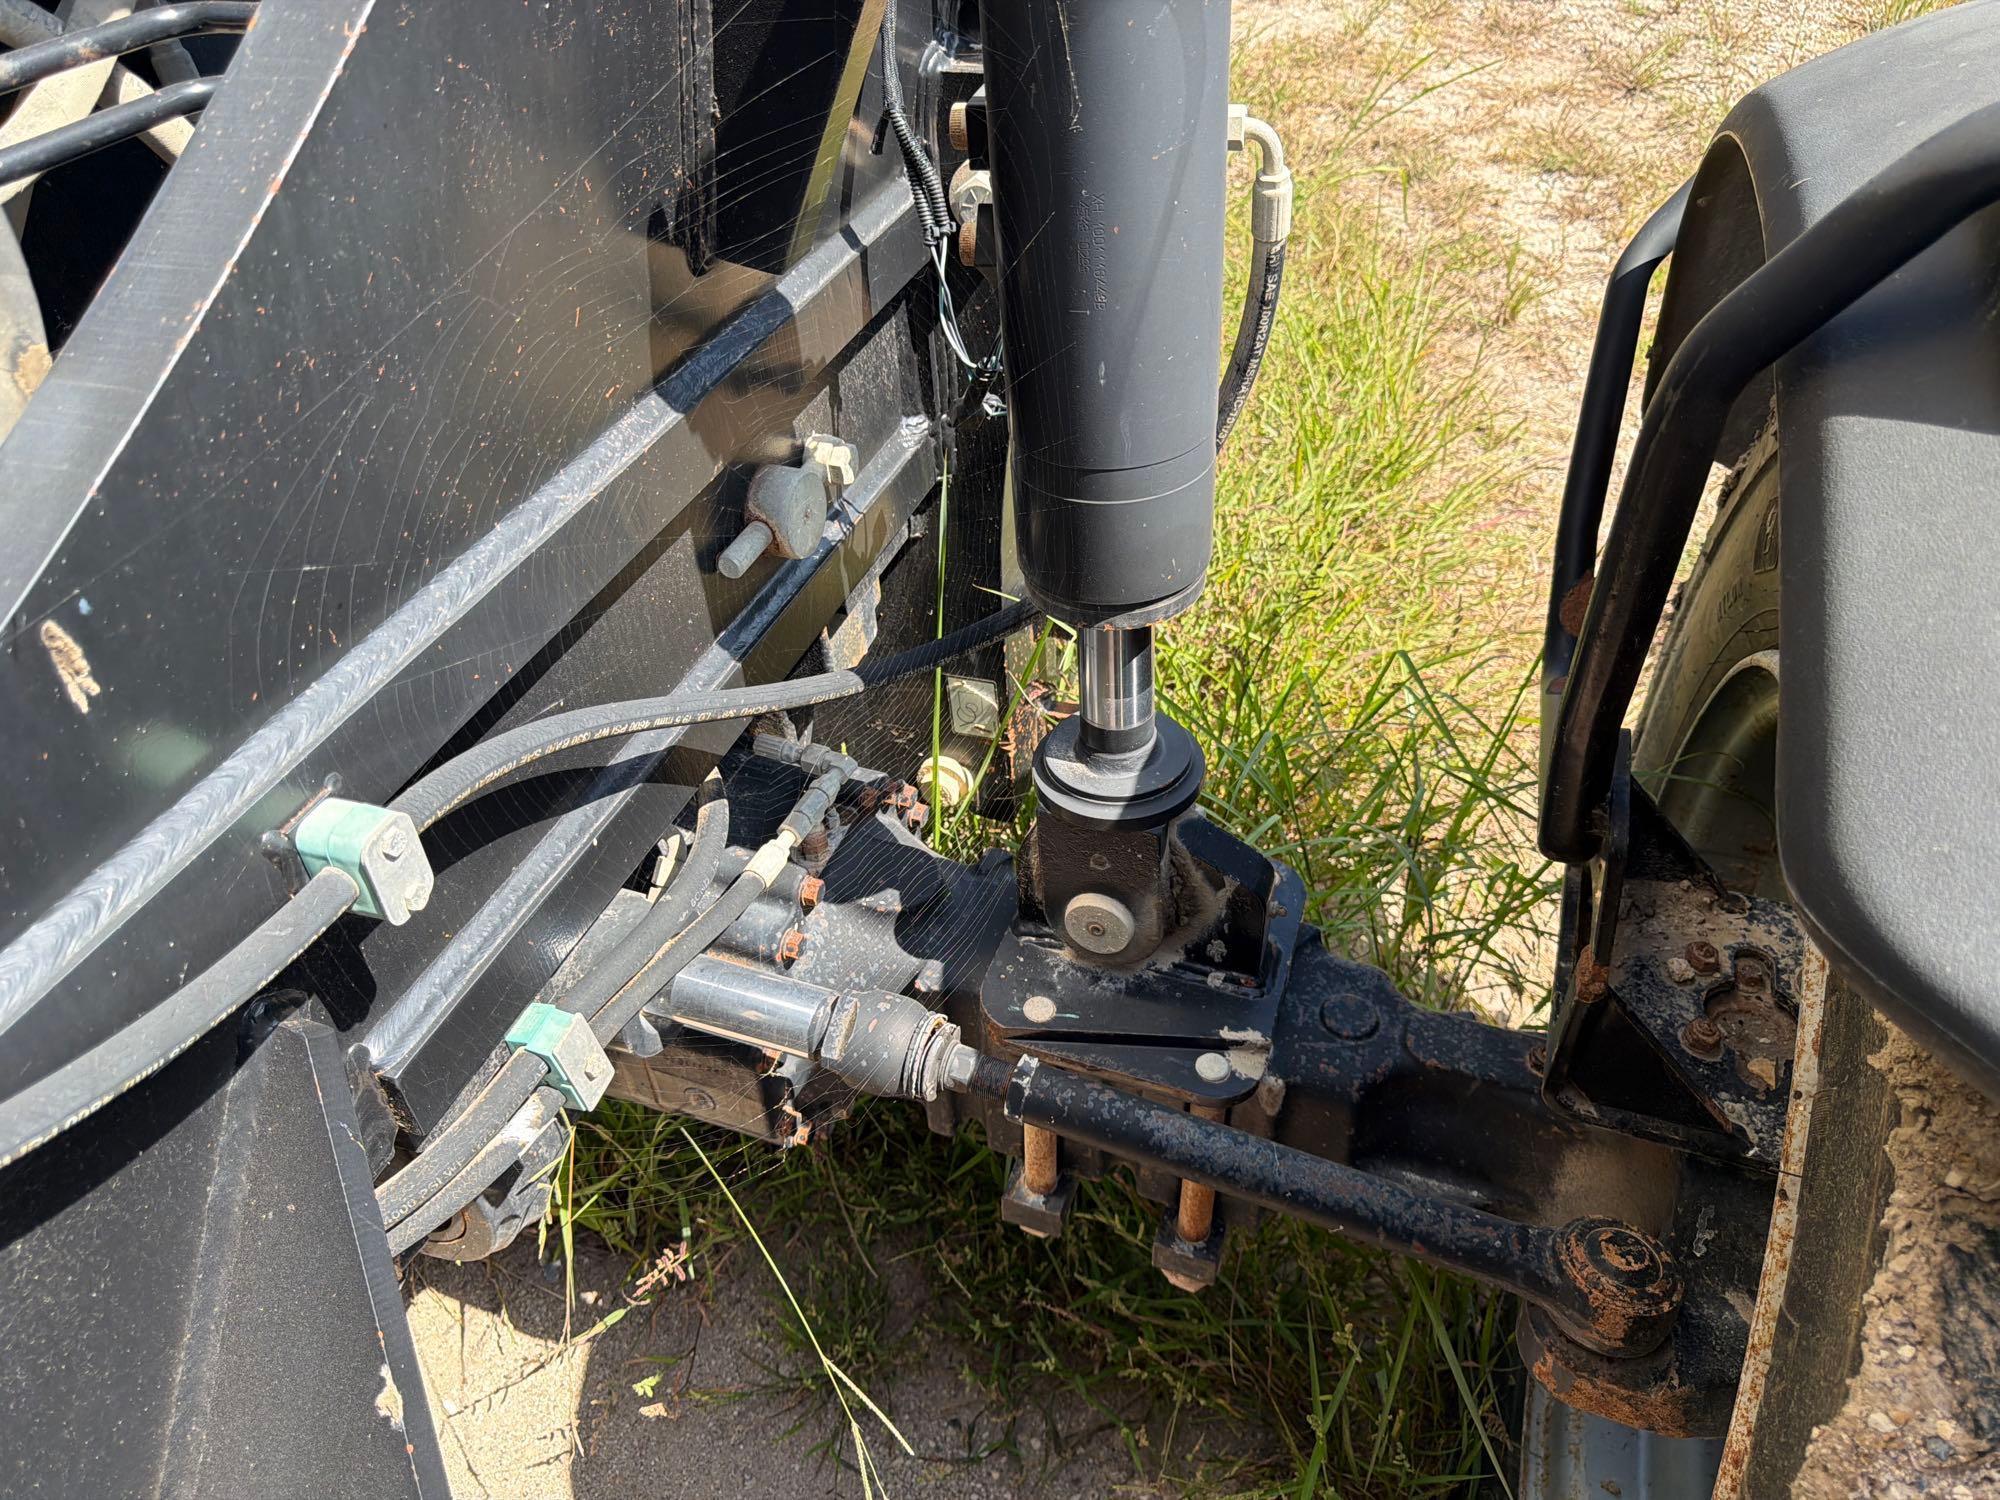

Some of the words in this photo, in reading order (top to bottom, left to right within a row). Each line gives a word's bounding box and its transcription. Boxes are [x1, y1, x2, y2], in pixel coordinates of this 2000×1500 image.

[1263, 274, 1279, 301] SAE
[1253, 302, 1276, 360] 100R2AT
[611, 724, 628, 735] PSI
